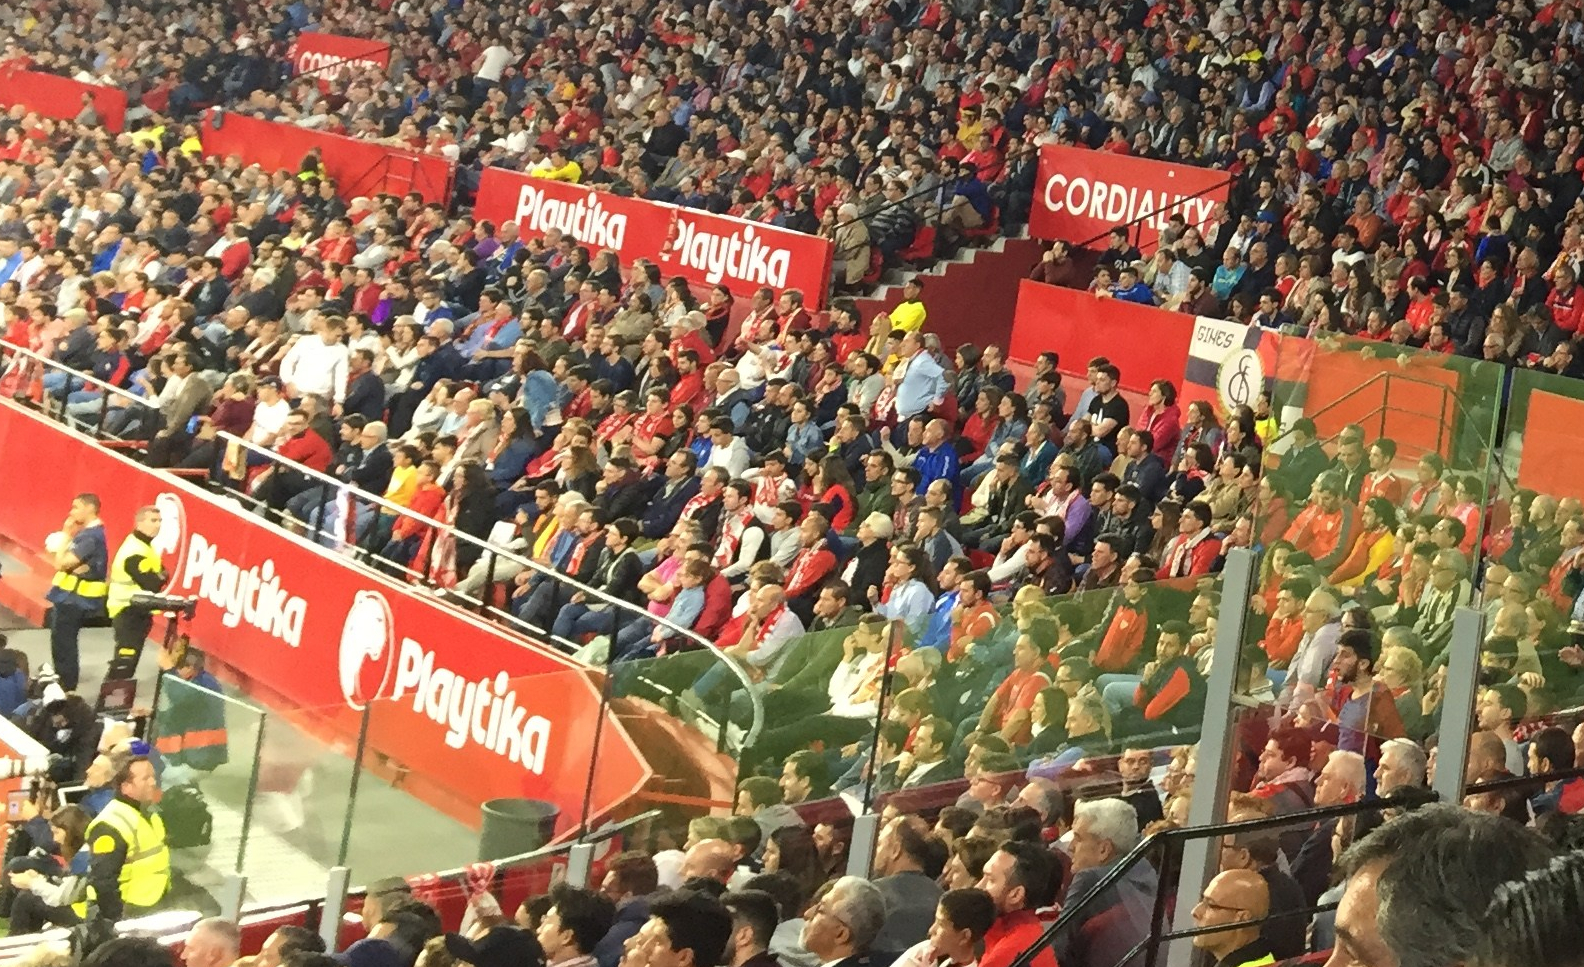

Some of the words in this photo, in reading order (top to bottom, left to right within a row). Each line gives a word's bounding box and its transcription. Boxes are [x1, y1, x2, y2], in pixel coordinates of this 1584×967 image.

[1044, 174, 1215, 232] CORDIALITY
[183, 533, 308, 647] Playtika
[392, 637, 551, 775] Playtika
